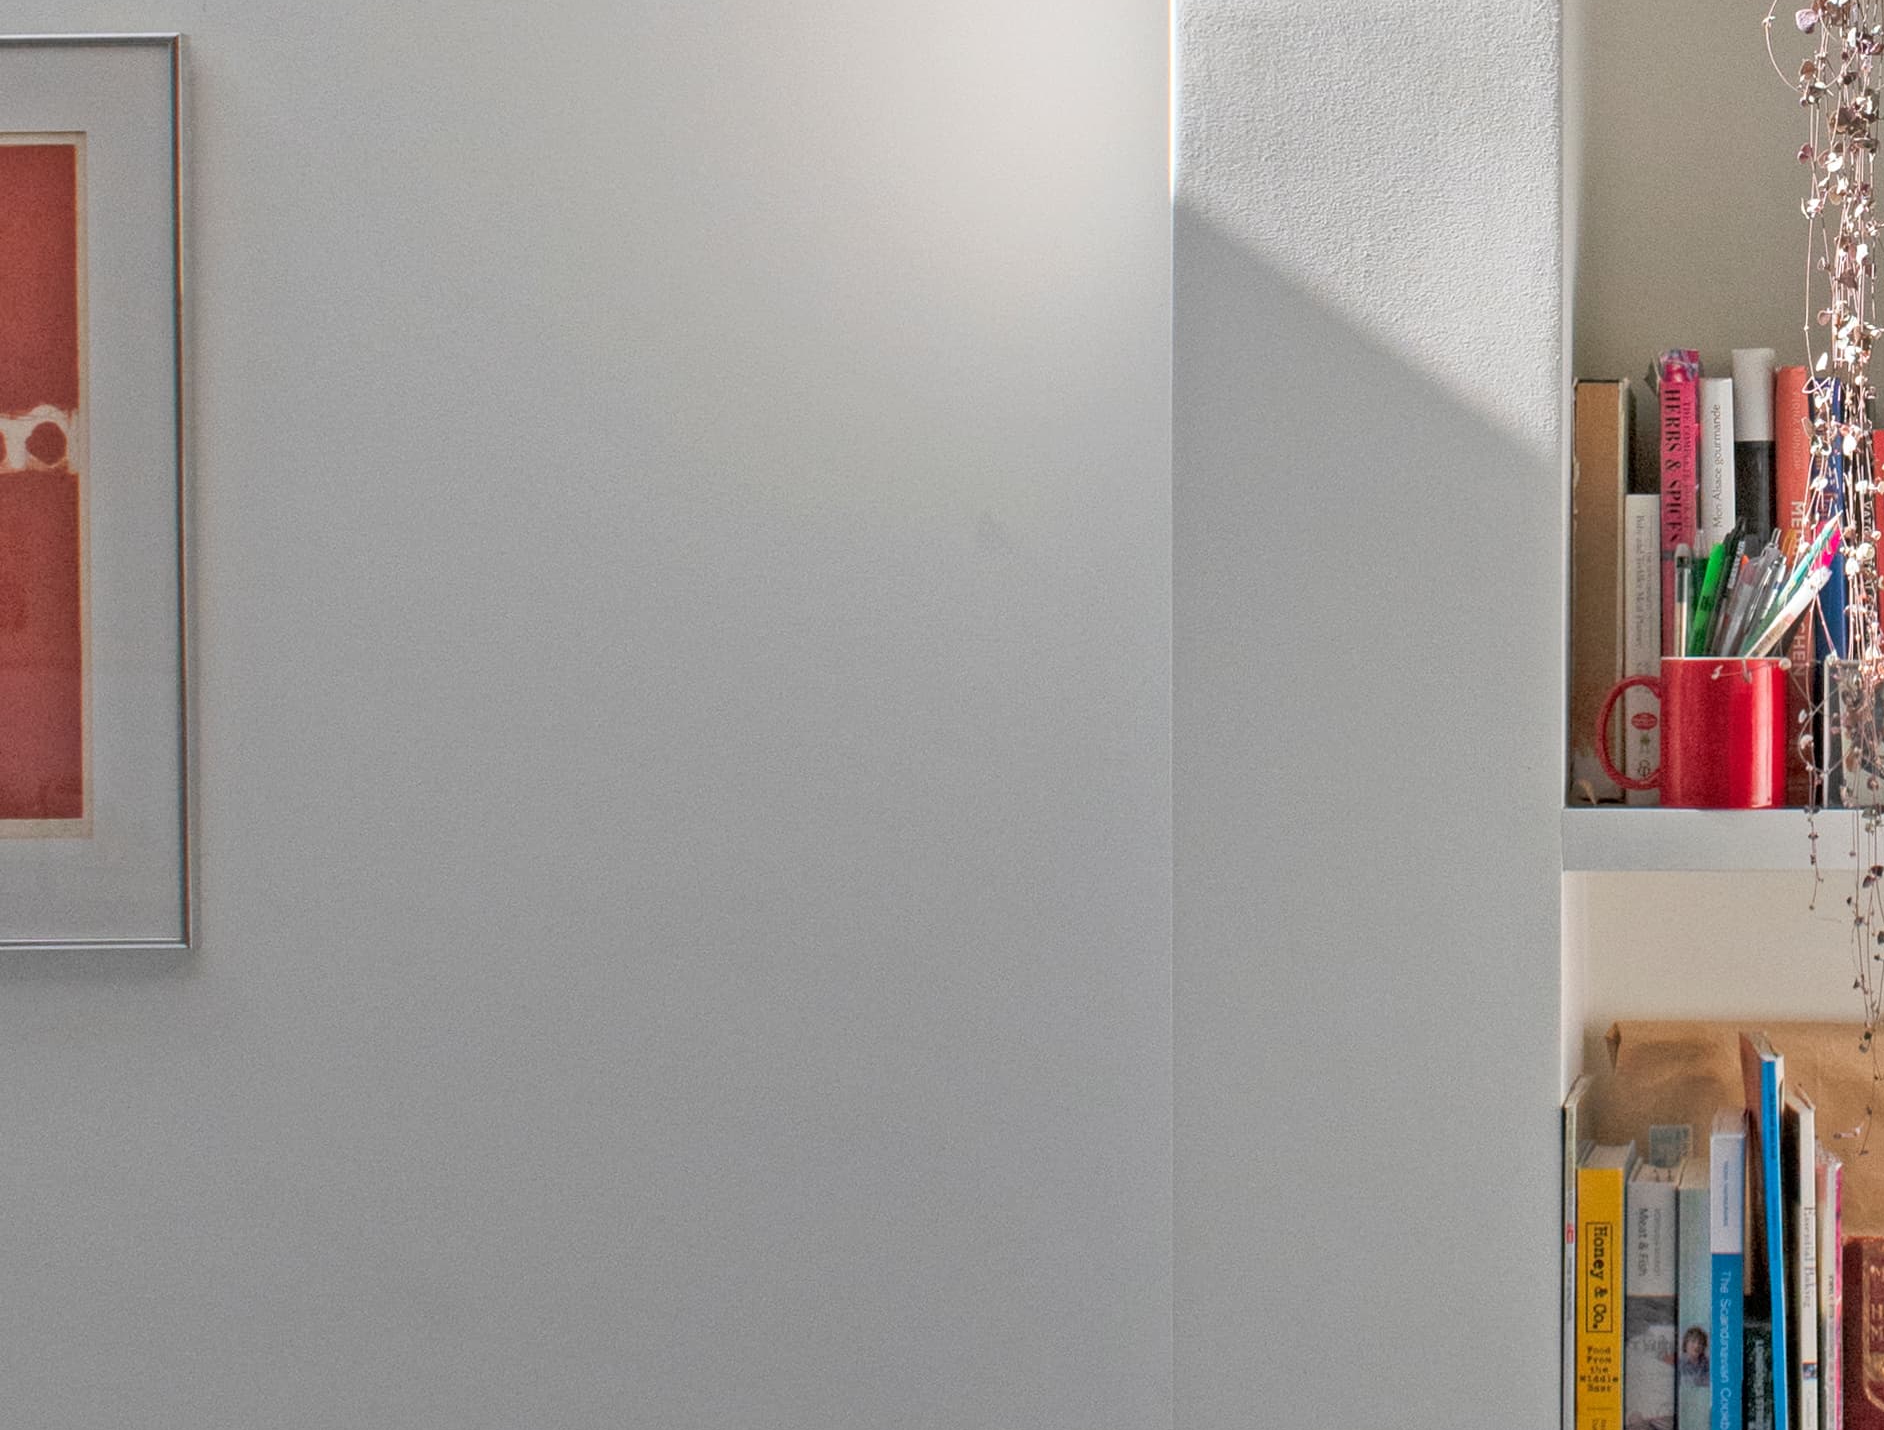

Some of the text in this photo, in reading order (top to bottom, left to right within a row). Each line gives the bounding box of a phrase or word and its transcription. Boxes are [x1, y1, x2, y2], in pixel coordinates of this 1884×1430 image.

[1664, 388, 1683, 543] HERBS & SPICES
[1710, 404, 1725, 528] Mon Alsace gourmande
[1638, 1207, 1649, 1239] Meat
[1590, 1225, 1608, 1330] Honey & Co.
[1638, 1252, 1649, 1277] Fish
[1720, 1270, 1732, 1294] The
[1719, 1297, 1733, 1384] Scandinavian
[1579, 1374, 1619, 1383] Middle
